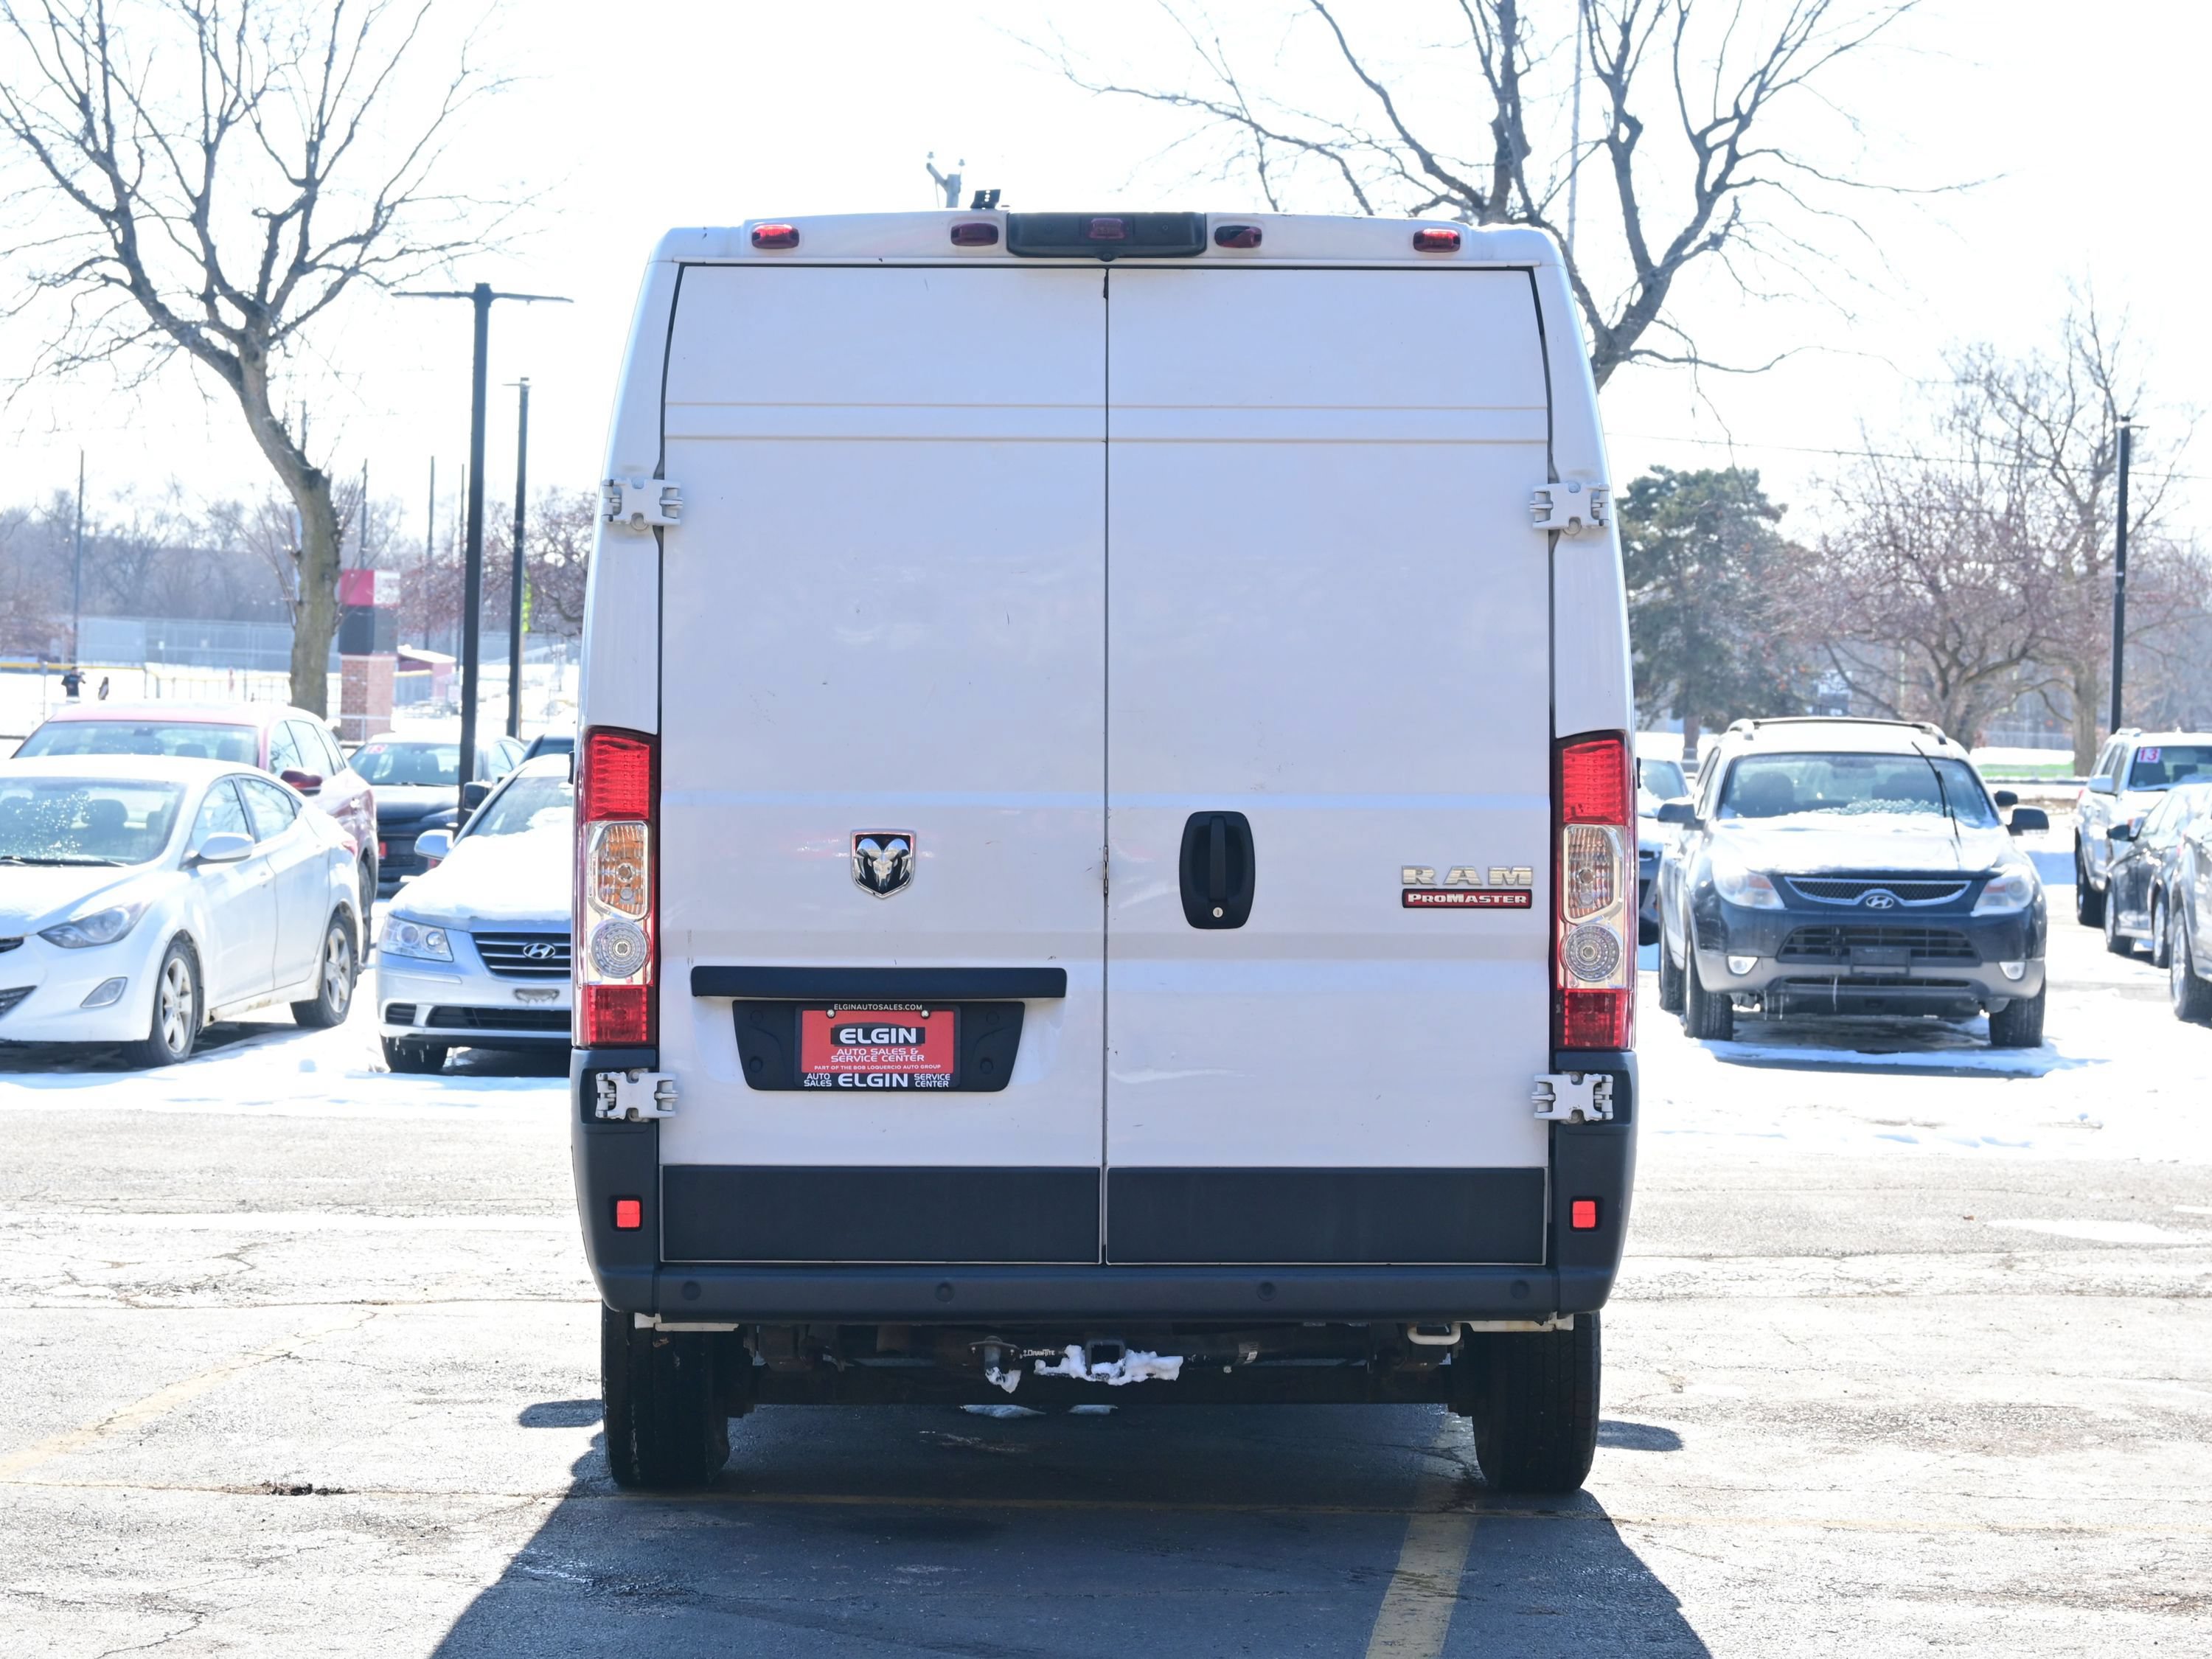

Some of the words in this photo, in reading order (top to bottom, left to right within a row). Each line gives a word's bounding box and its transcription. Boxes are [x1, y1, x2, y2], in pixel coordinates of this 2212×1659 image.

[2140, 748, 2157, 761] 13
[1402, 866, 1533, 886] RAM
[839, 1028, 917, 1044] ELGIN
[838, 1073, 908, 1088] ELGIN
